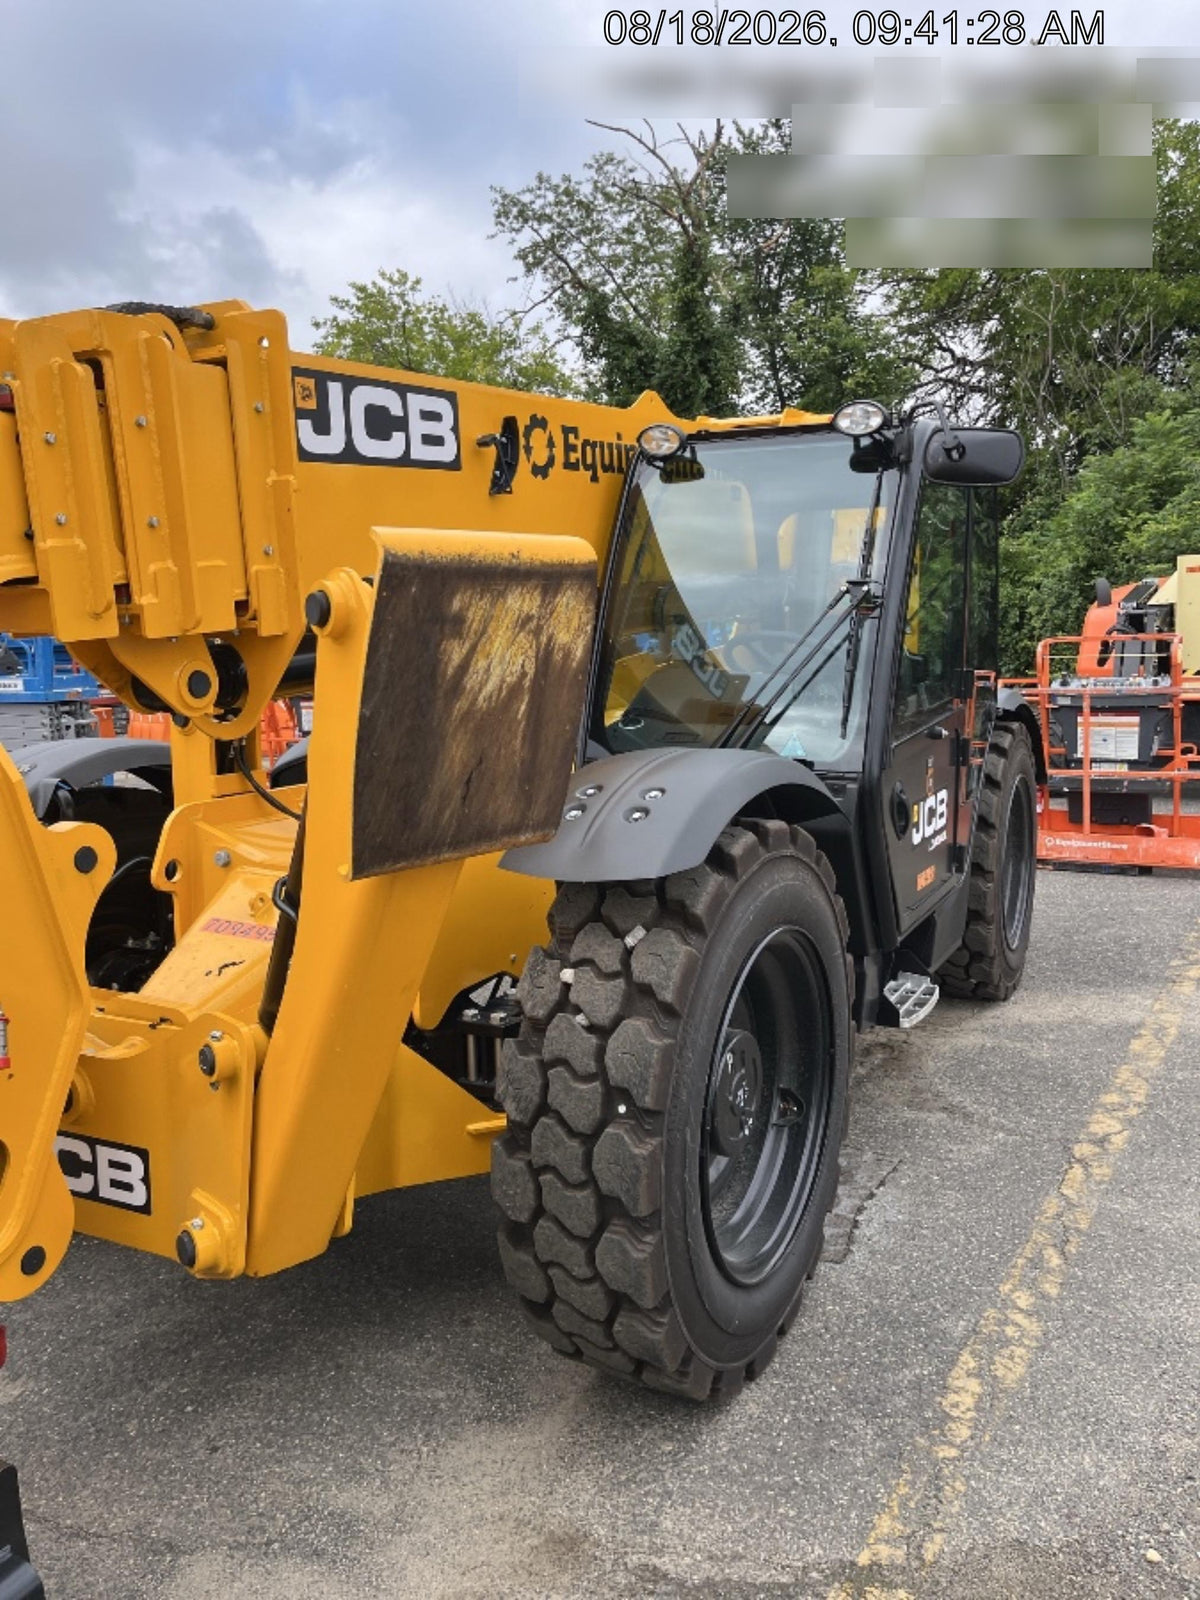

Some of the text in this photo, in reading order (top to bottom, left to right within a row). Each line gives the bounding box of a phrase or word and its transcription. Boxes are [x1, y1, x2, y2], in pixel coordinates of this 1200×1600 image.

[296, 379, 458, 463] JCB
[912, 789, 948, 846] JCB
[53, 1135, 148, 1207] CB
